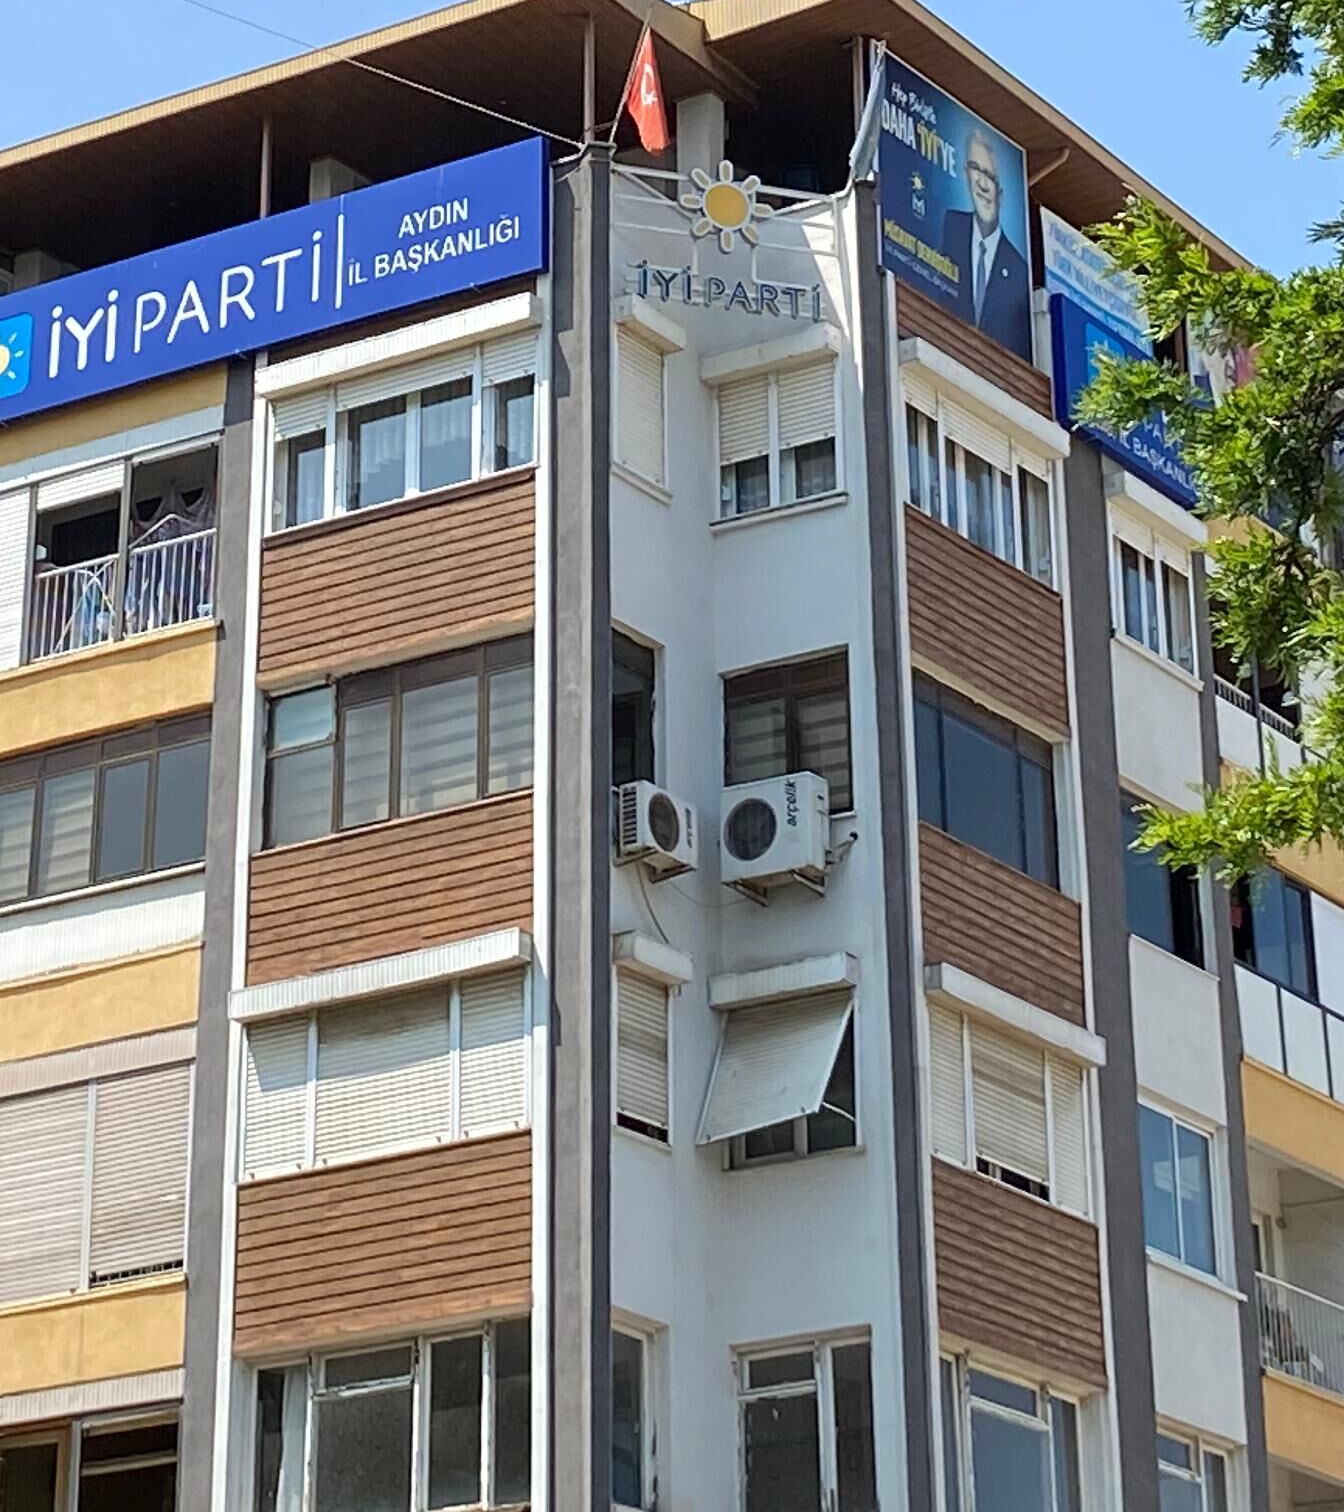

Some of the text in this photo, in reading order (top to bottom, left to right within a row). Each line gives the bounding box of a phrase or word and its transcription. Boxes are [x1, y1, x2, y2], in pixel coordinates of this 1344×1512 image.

[881, 98, 917, 150] DAHA
[374, 214, 520, 279] BAŞKANLIĞI
[398, 197, 469, 239] AYDIN
[49, 230, 322, 379] İYİ PARTİ
[639, 259, 822, 322] İYİ PARTİ
